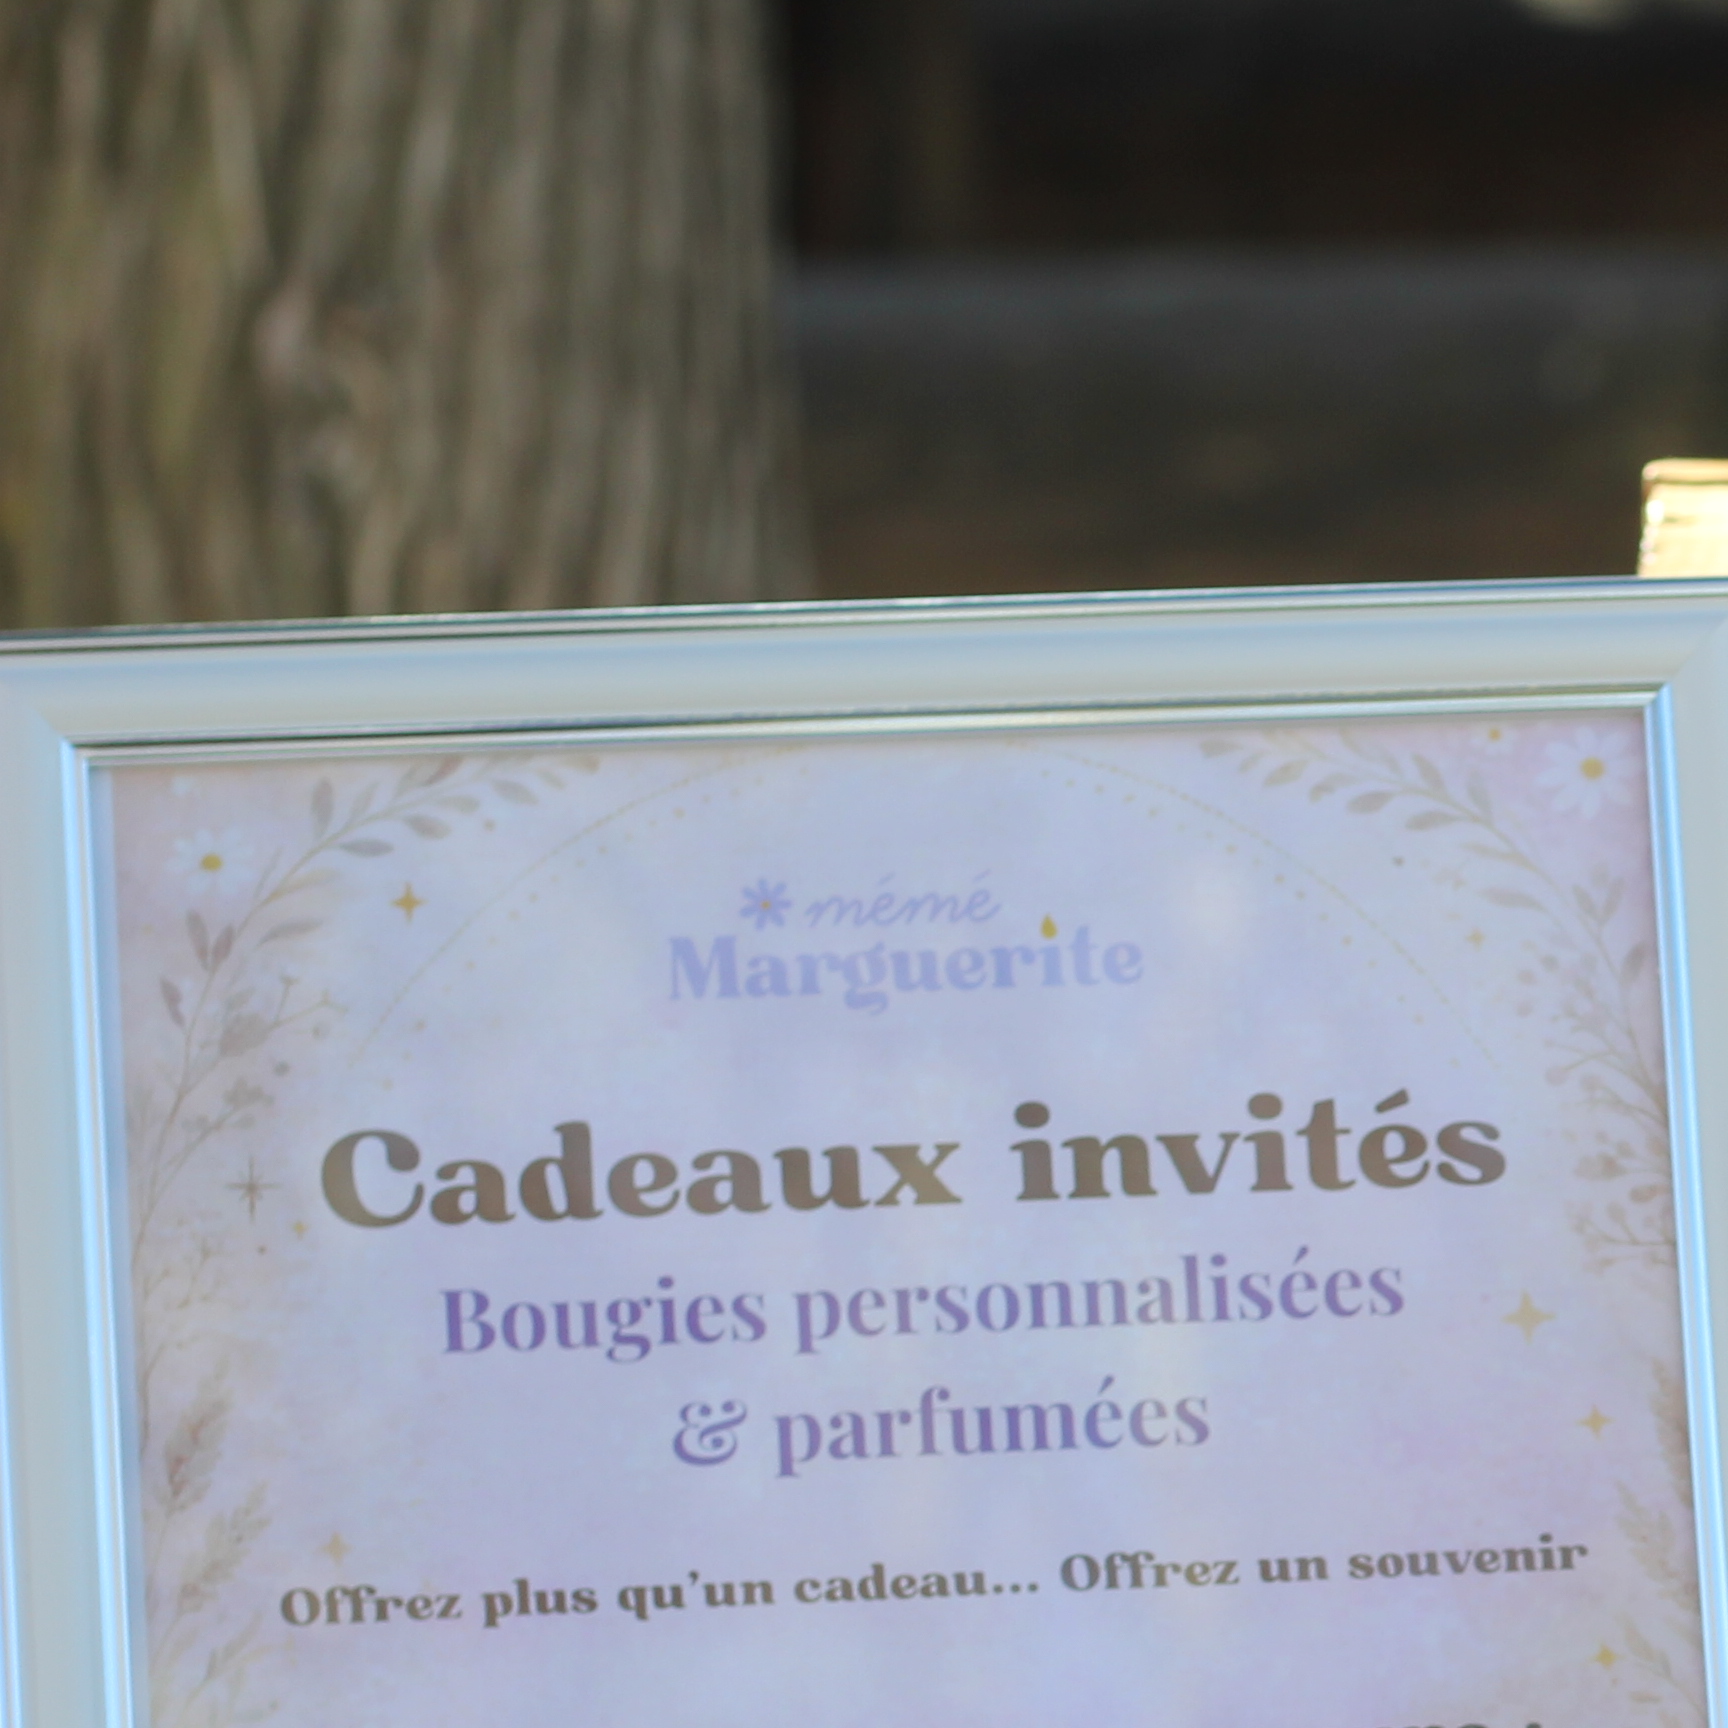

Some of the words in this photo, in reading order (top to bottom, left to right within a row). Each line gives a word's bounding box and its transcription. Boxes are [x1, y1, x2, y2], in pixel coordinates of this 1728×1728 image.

[803, 874, 1000, 930] mémé
[666, 920, 1143, 1012] Marguerite
[321, 1122, 960, 1228] Cadeaux
[1009, 1089, 1507, 1202] invités
[441, 1276, 769, 1365] Bougies
[791, 1243, 1404, 1356] personnalisées
[672, 1399, 748, 1467] &
[772, 1375, 1210, 1478] parfumées
[279, 1580, 465, 1629] Offrez
[481, 1574, 600, 1629] plus
[615, 1567, 778, 1620] qu'un
[791, 1556, 1041, 1605] cadeau...
[1058, 1546, 1242, 1597] Offrez
[1256, 1549, 1330, 1588] un
[1345, 1533, 1588, 1582] souvenir
